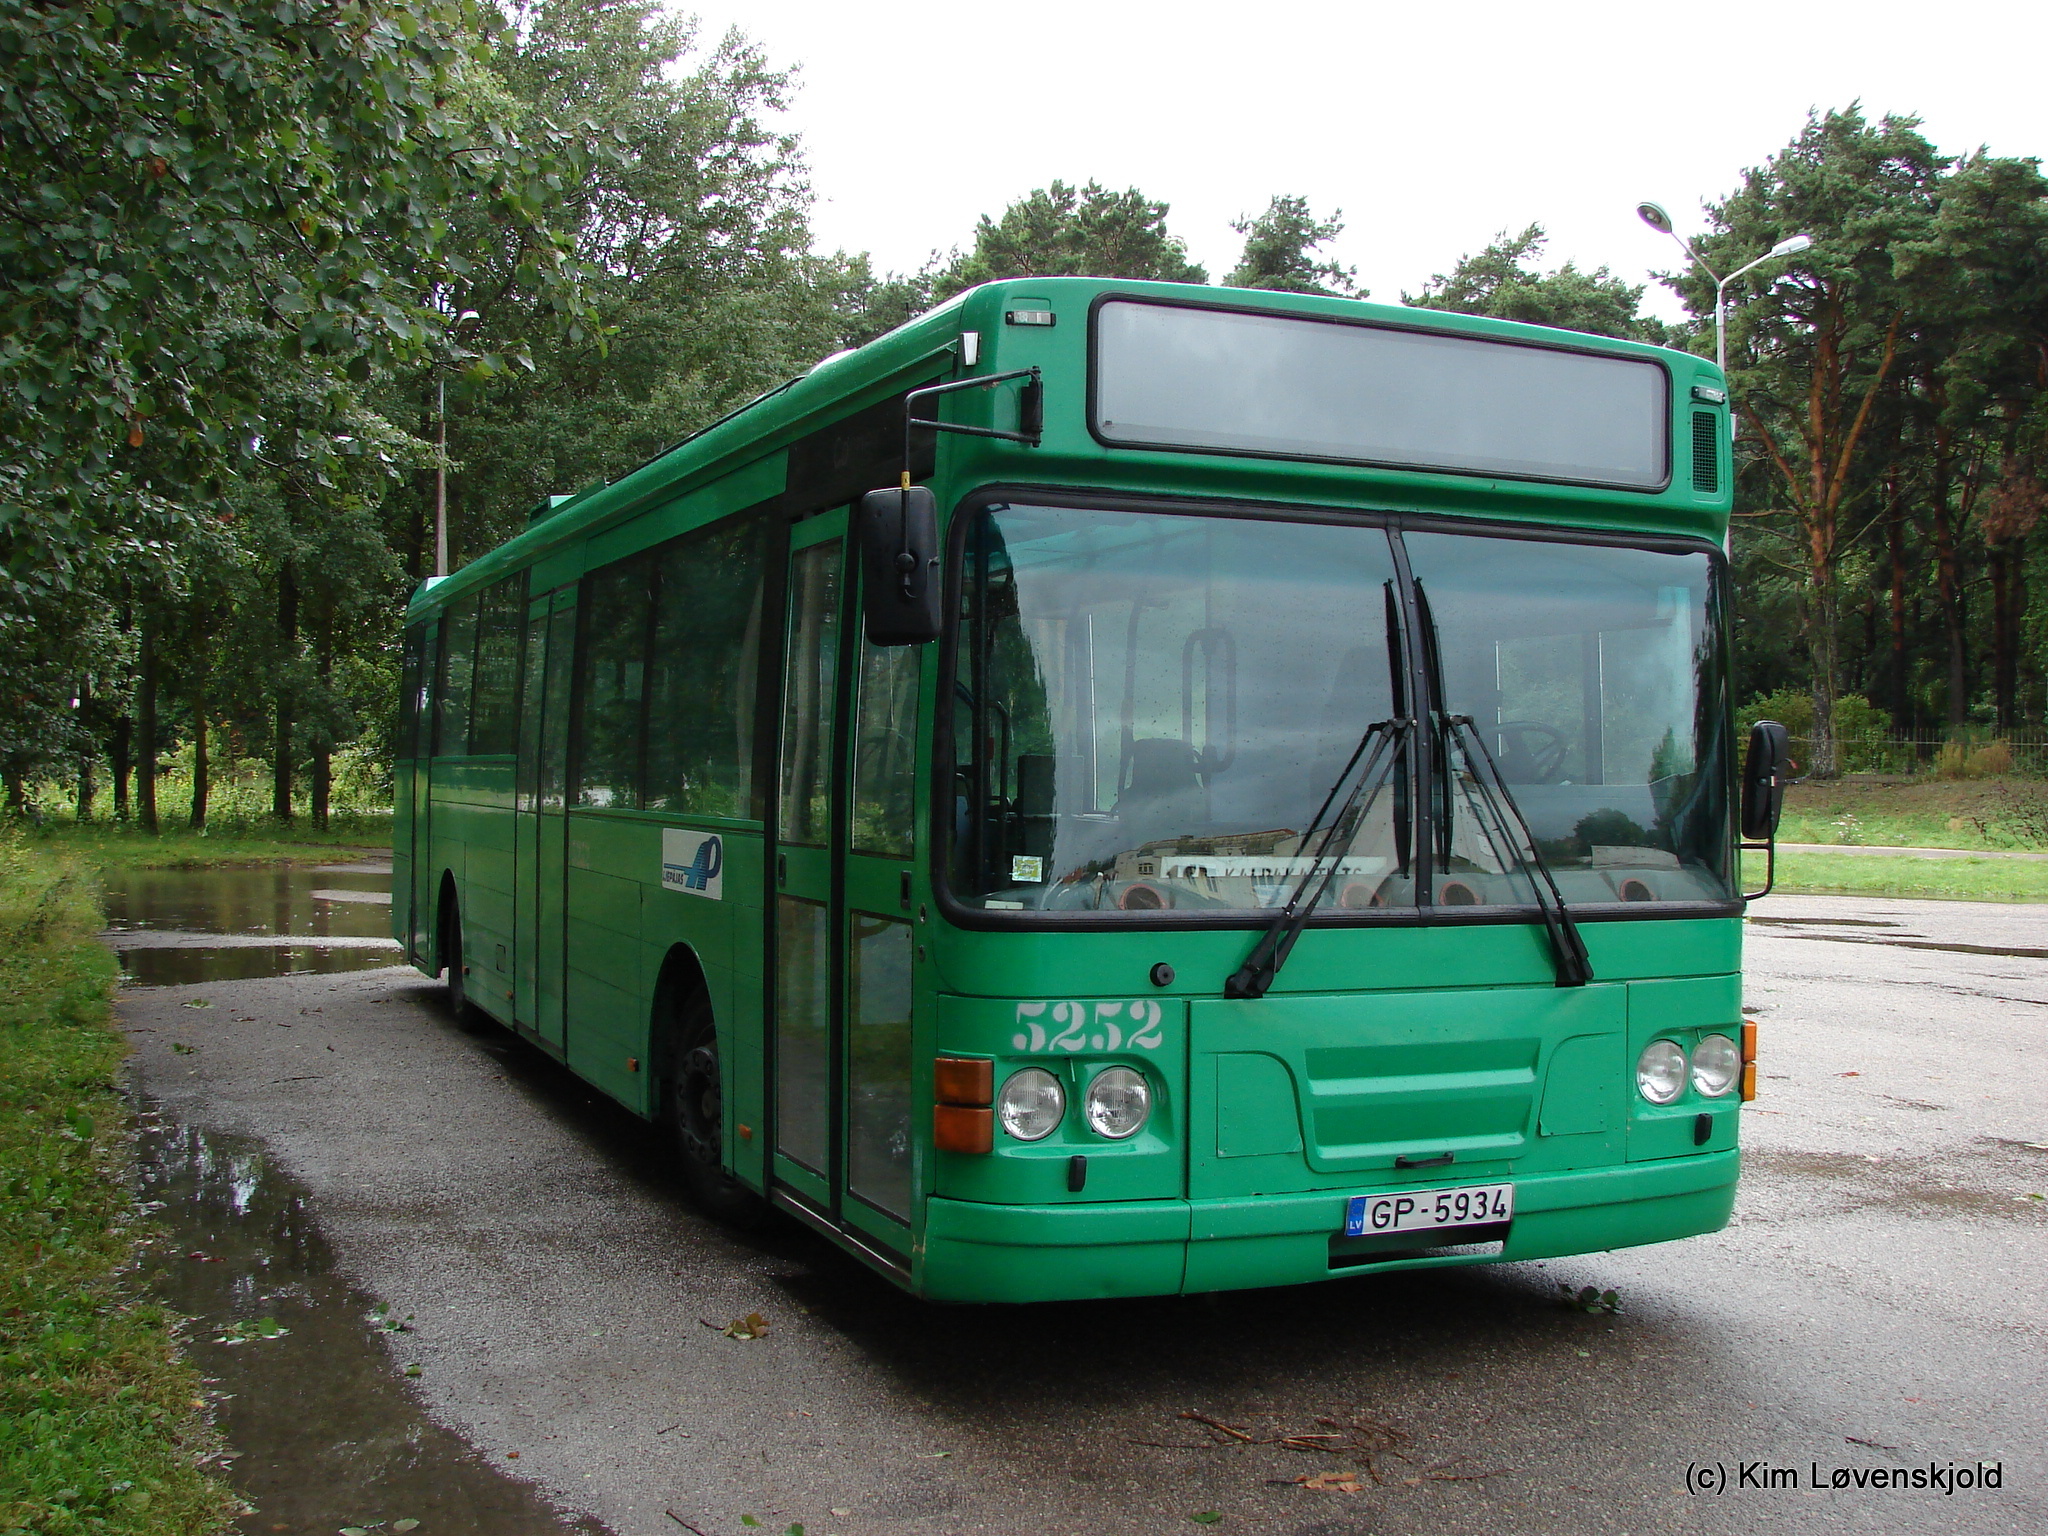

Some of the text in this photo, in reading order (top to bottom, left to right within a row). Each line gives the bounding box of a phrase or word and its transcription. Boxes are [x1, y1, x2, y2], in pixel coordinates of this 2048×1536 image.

[1012, 1000, 1163, 1052] 5252
[1349, 1220, 1363, 1230] LV
[1372, 1189, 1507, 1229] GP-5934
